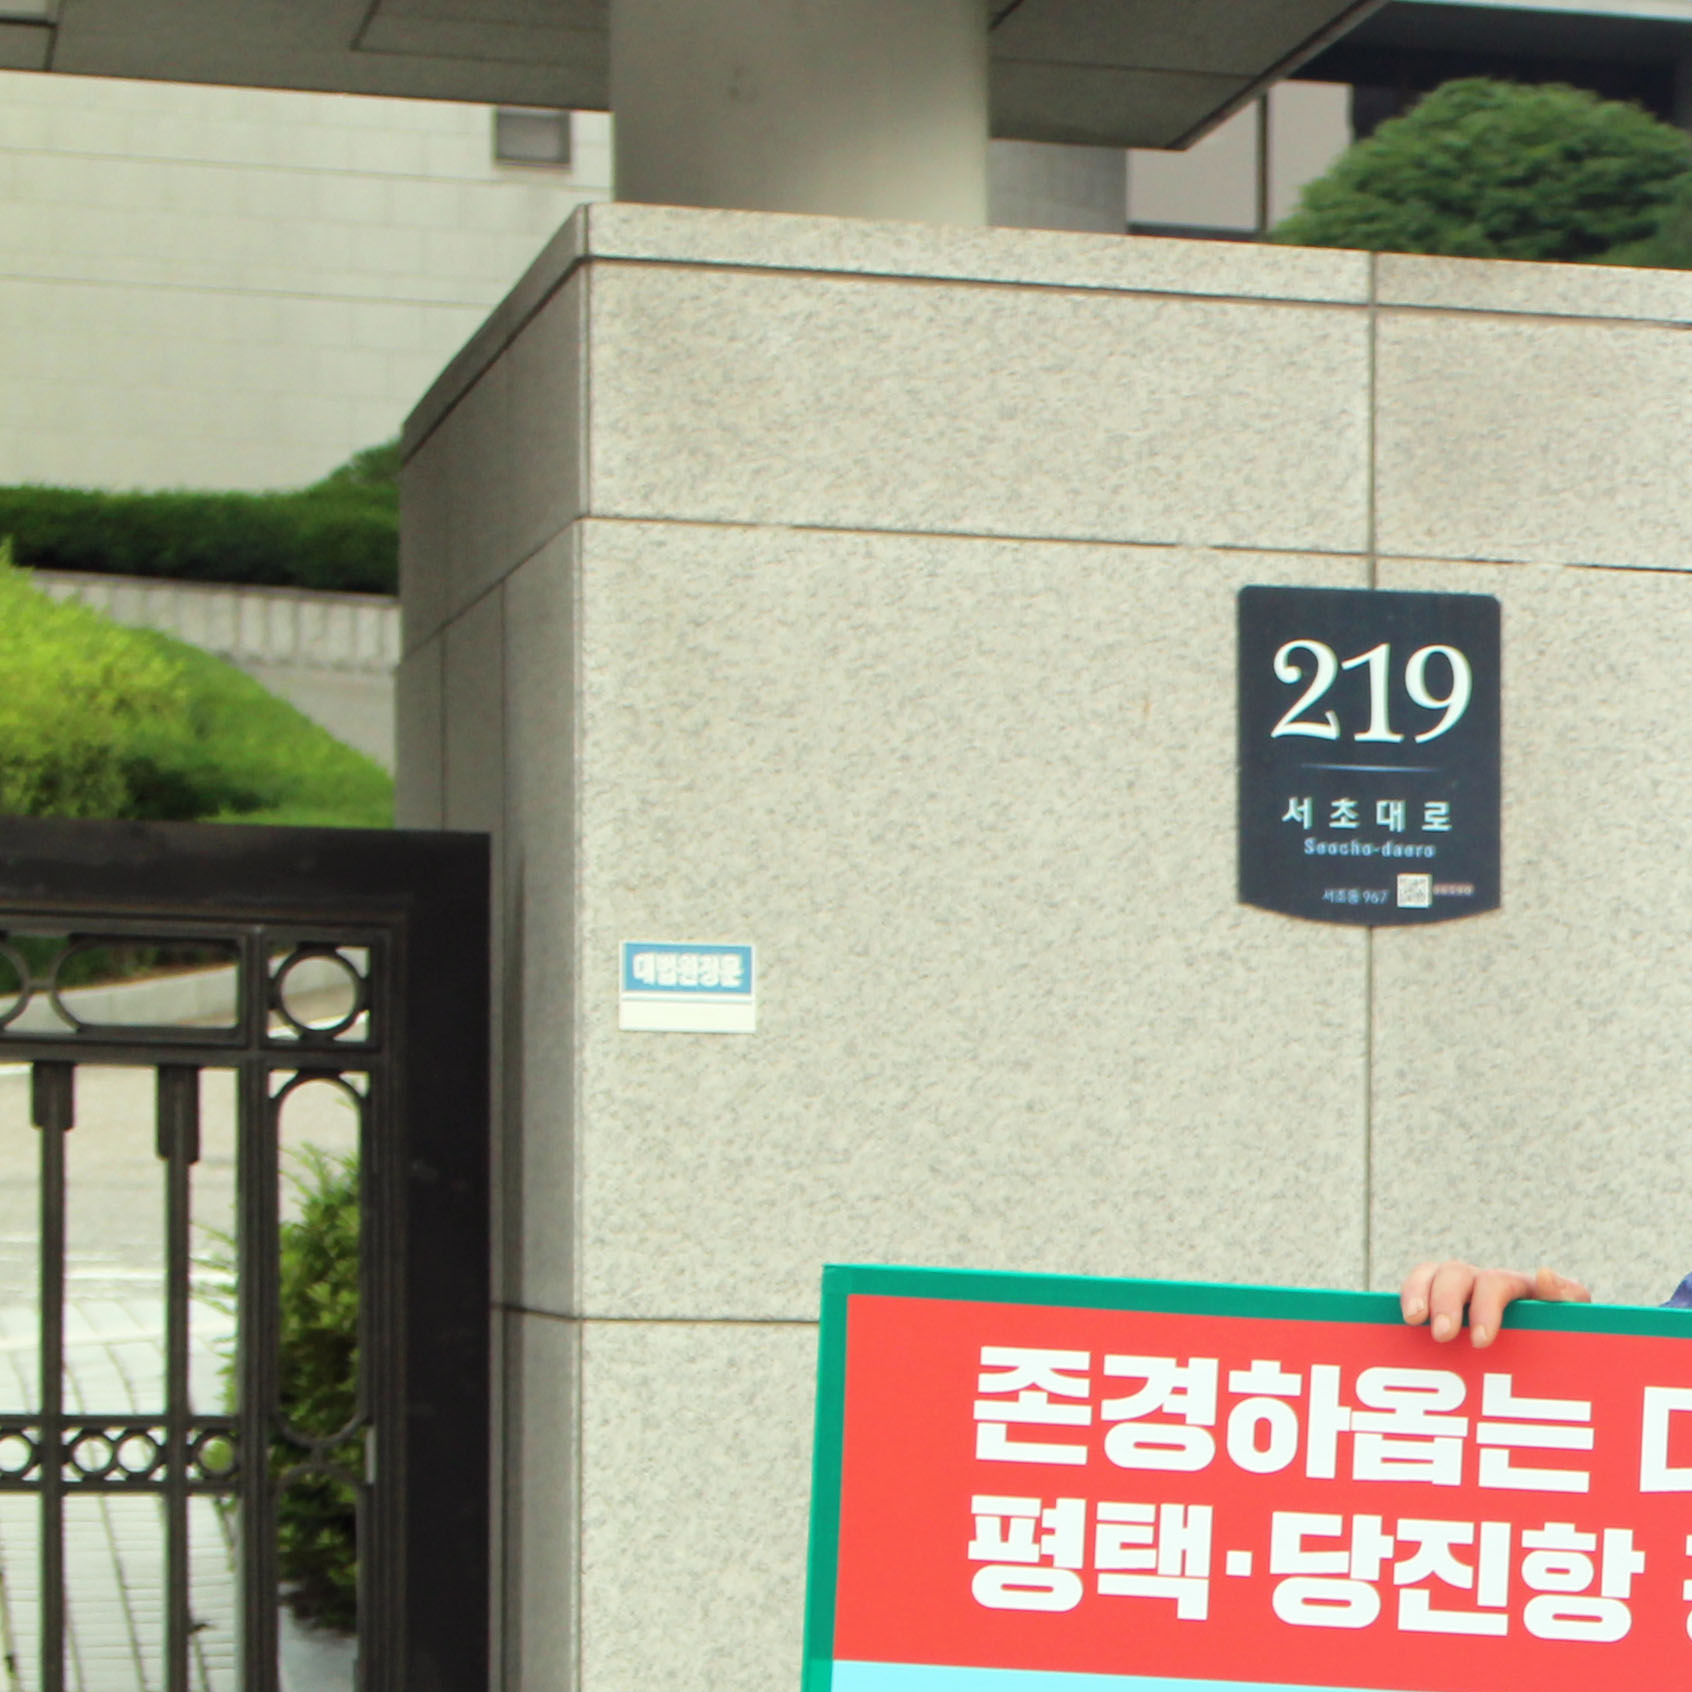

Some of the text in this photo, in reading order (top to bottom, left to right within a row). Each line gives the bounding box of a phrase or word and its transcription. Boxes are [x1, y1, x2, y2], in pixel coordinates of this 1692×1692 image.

[1270, 638, 1473, 744] 219
[1282, 796, 1452, 833] 서초대로
[1304, 837, 1436, 859] Seocho-daero
[1362, 889, 1389, 905] 967
[973, 1345, 1595, 1494] 존경하옵는
[968, 1494, 1645, 1643] 평택·당진항
